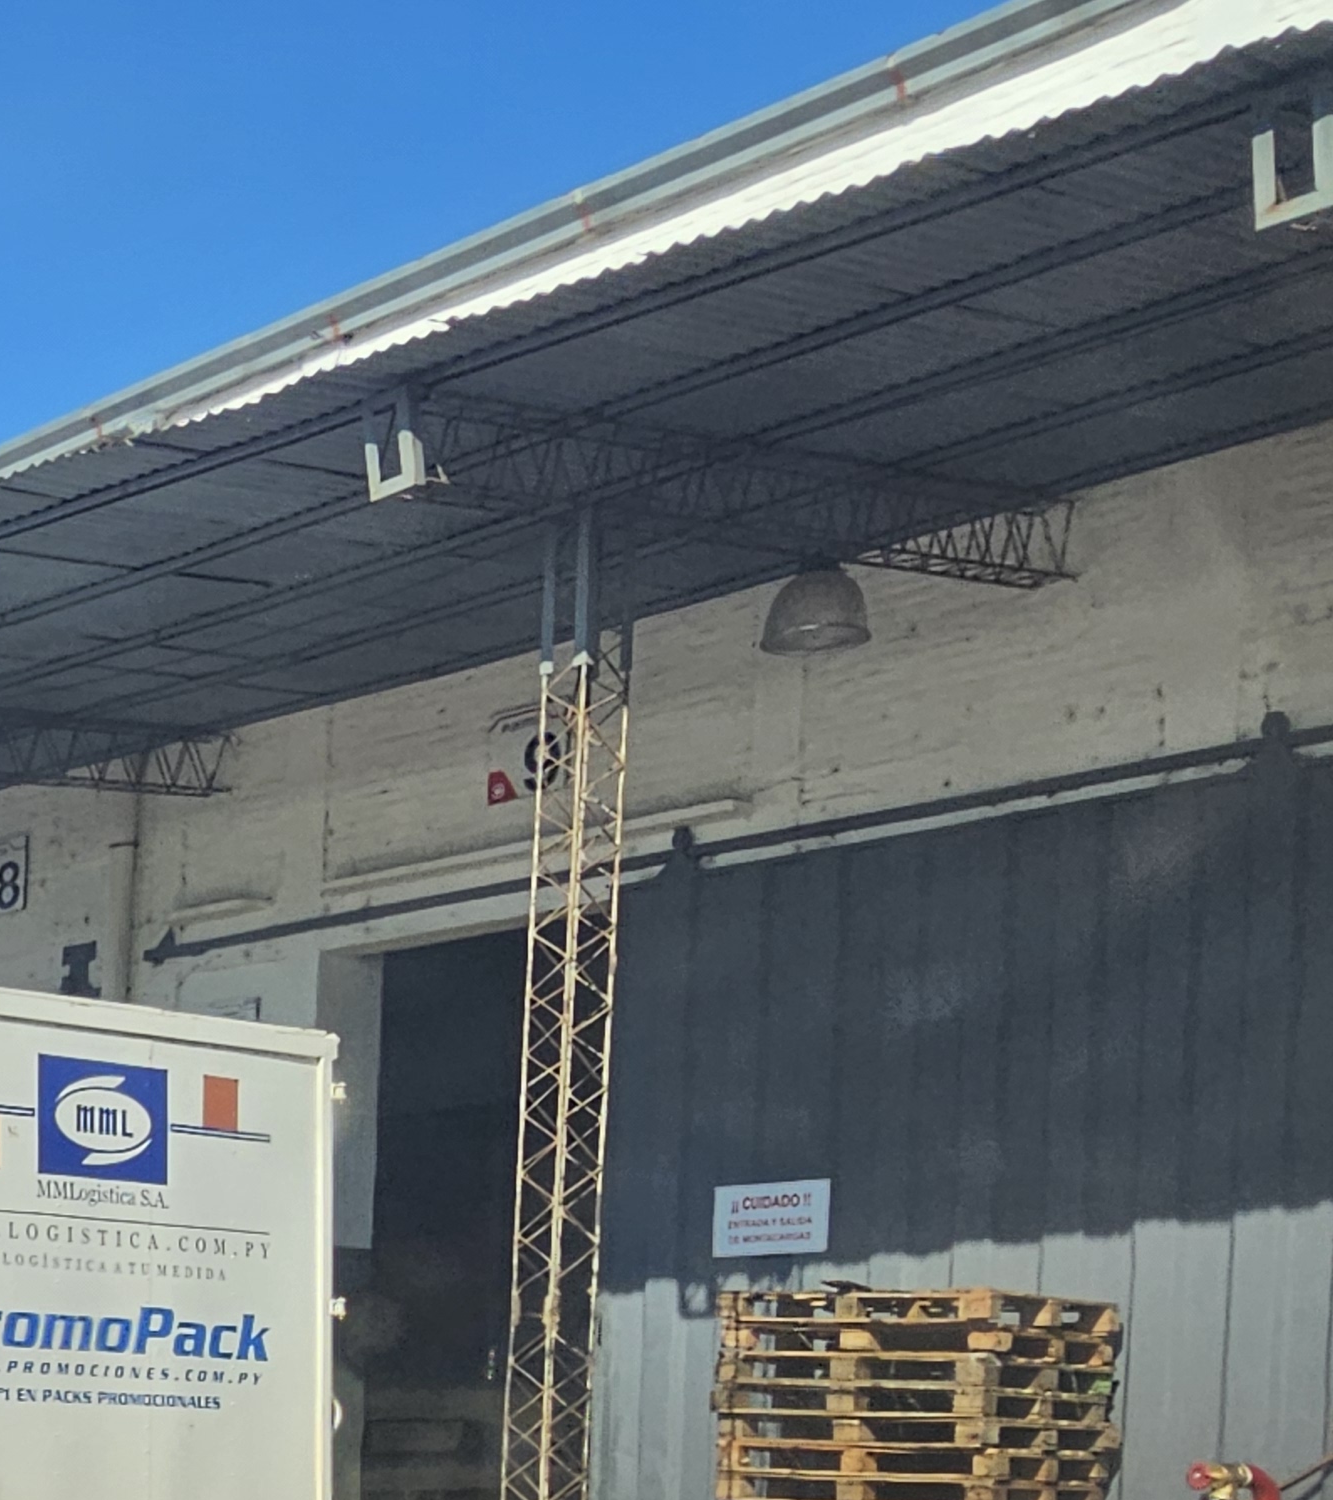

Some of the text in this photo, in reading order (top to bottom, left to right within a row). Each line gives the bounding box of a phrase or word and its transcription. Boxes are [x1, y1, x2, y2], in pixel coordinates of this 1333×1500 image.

[523, 731, 561, 791] 9
[742, 1192, 801, 1211] CUIDADO
[128, 1262, 152, 1276] TU
[156, 1264, 227, 1281] MEDIDA
[16, 1387, 37, 1402] EN
[42, 1389, 93, 1404] PACKS
[97, 1391, 222, 1410] PROMOCIONALES
